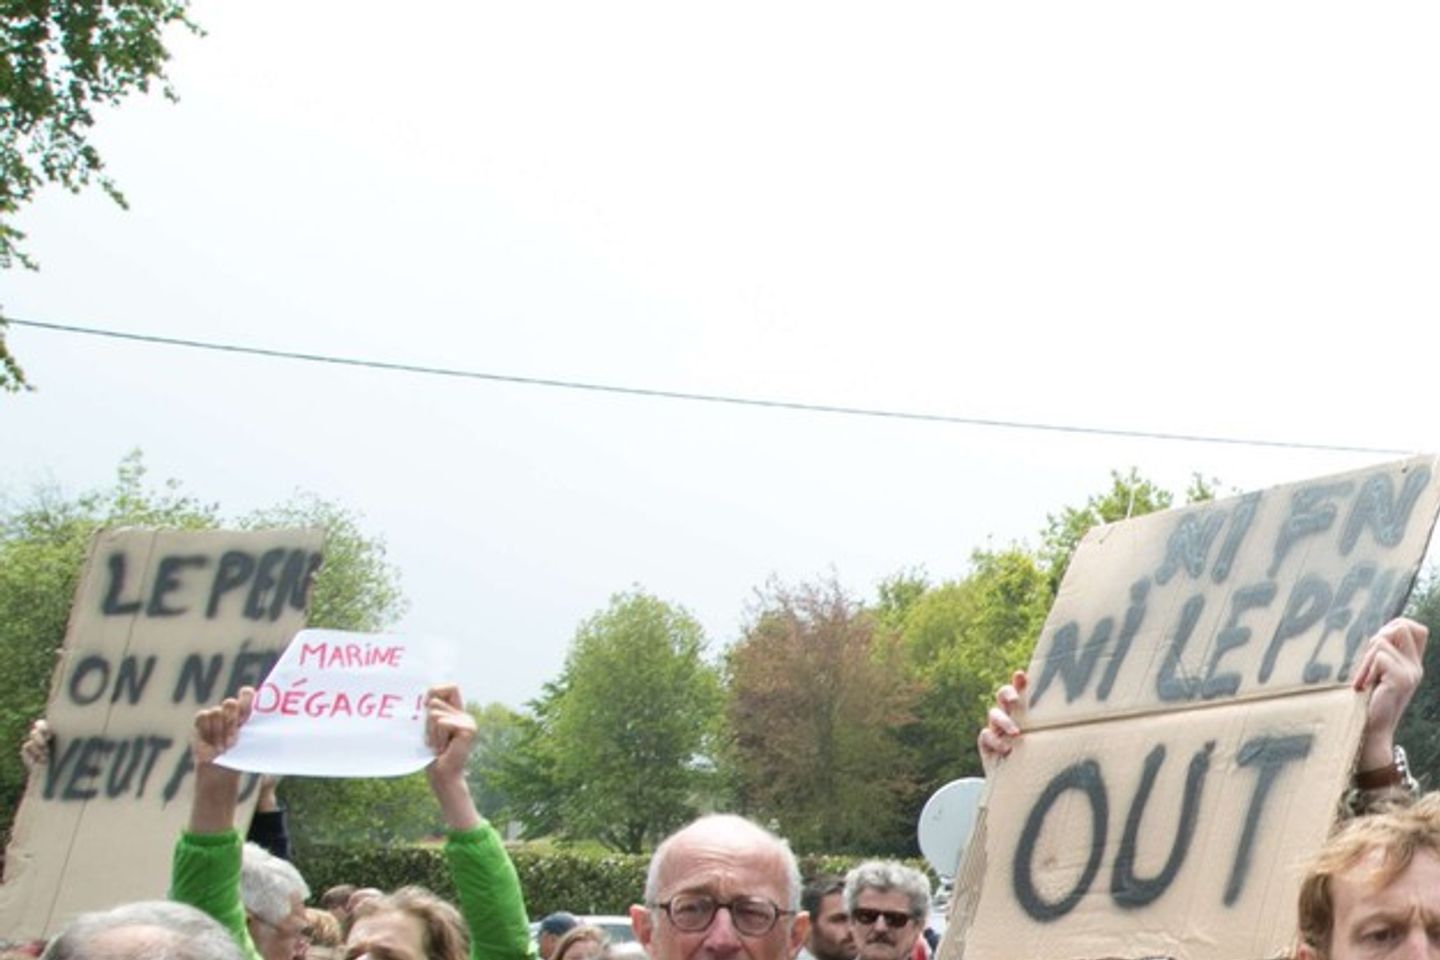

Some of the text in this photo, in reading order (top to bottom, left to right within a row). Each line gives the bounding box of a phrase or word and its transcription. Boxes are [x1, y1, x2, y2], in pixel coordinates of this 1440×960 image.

[1154, 464, 1433, 586] NI FN
[66, 653, 158, 706] ON
[254, 677, 423, 721] DÉGAGE !
[42, 734, 173, 802] VEUT
[1012, 732, 1315, 922] OUT
